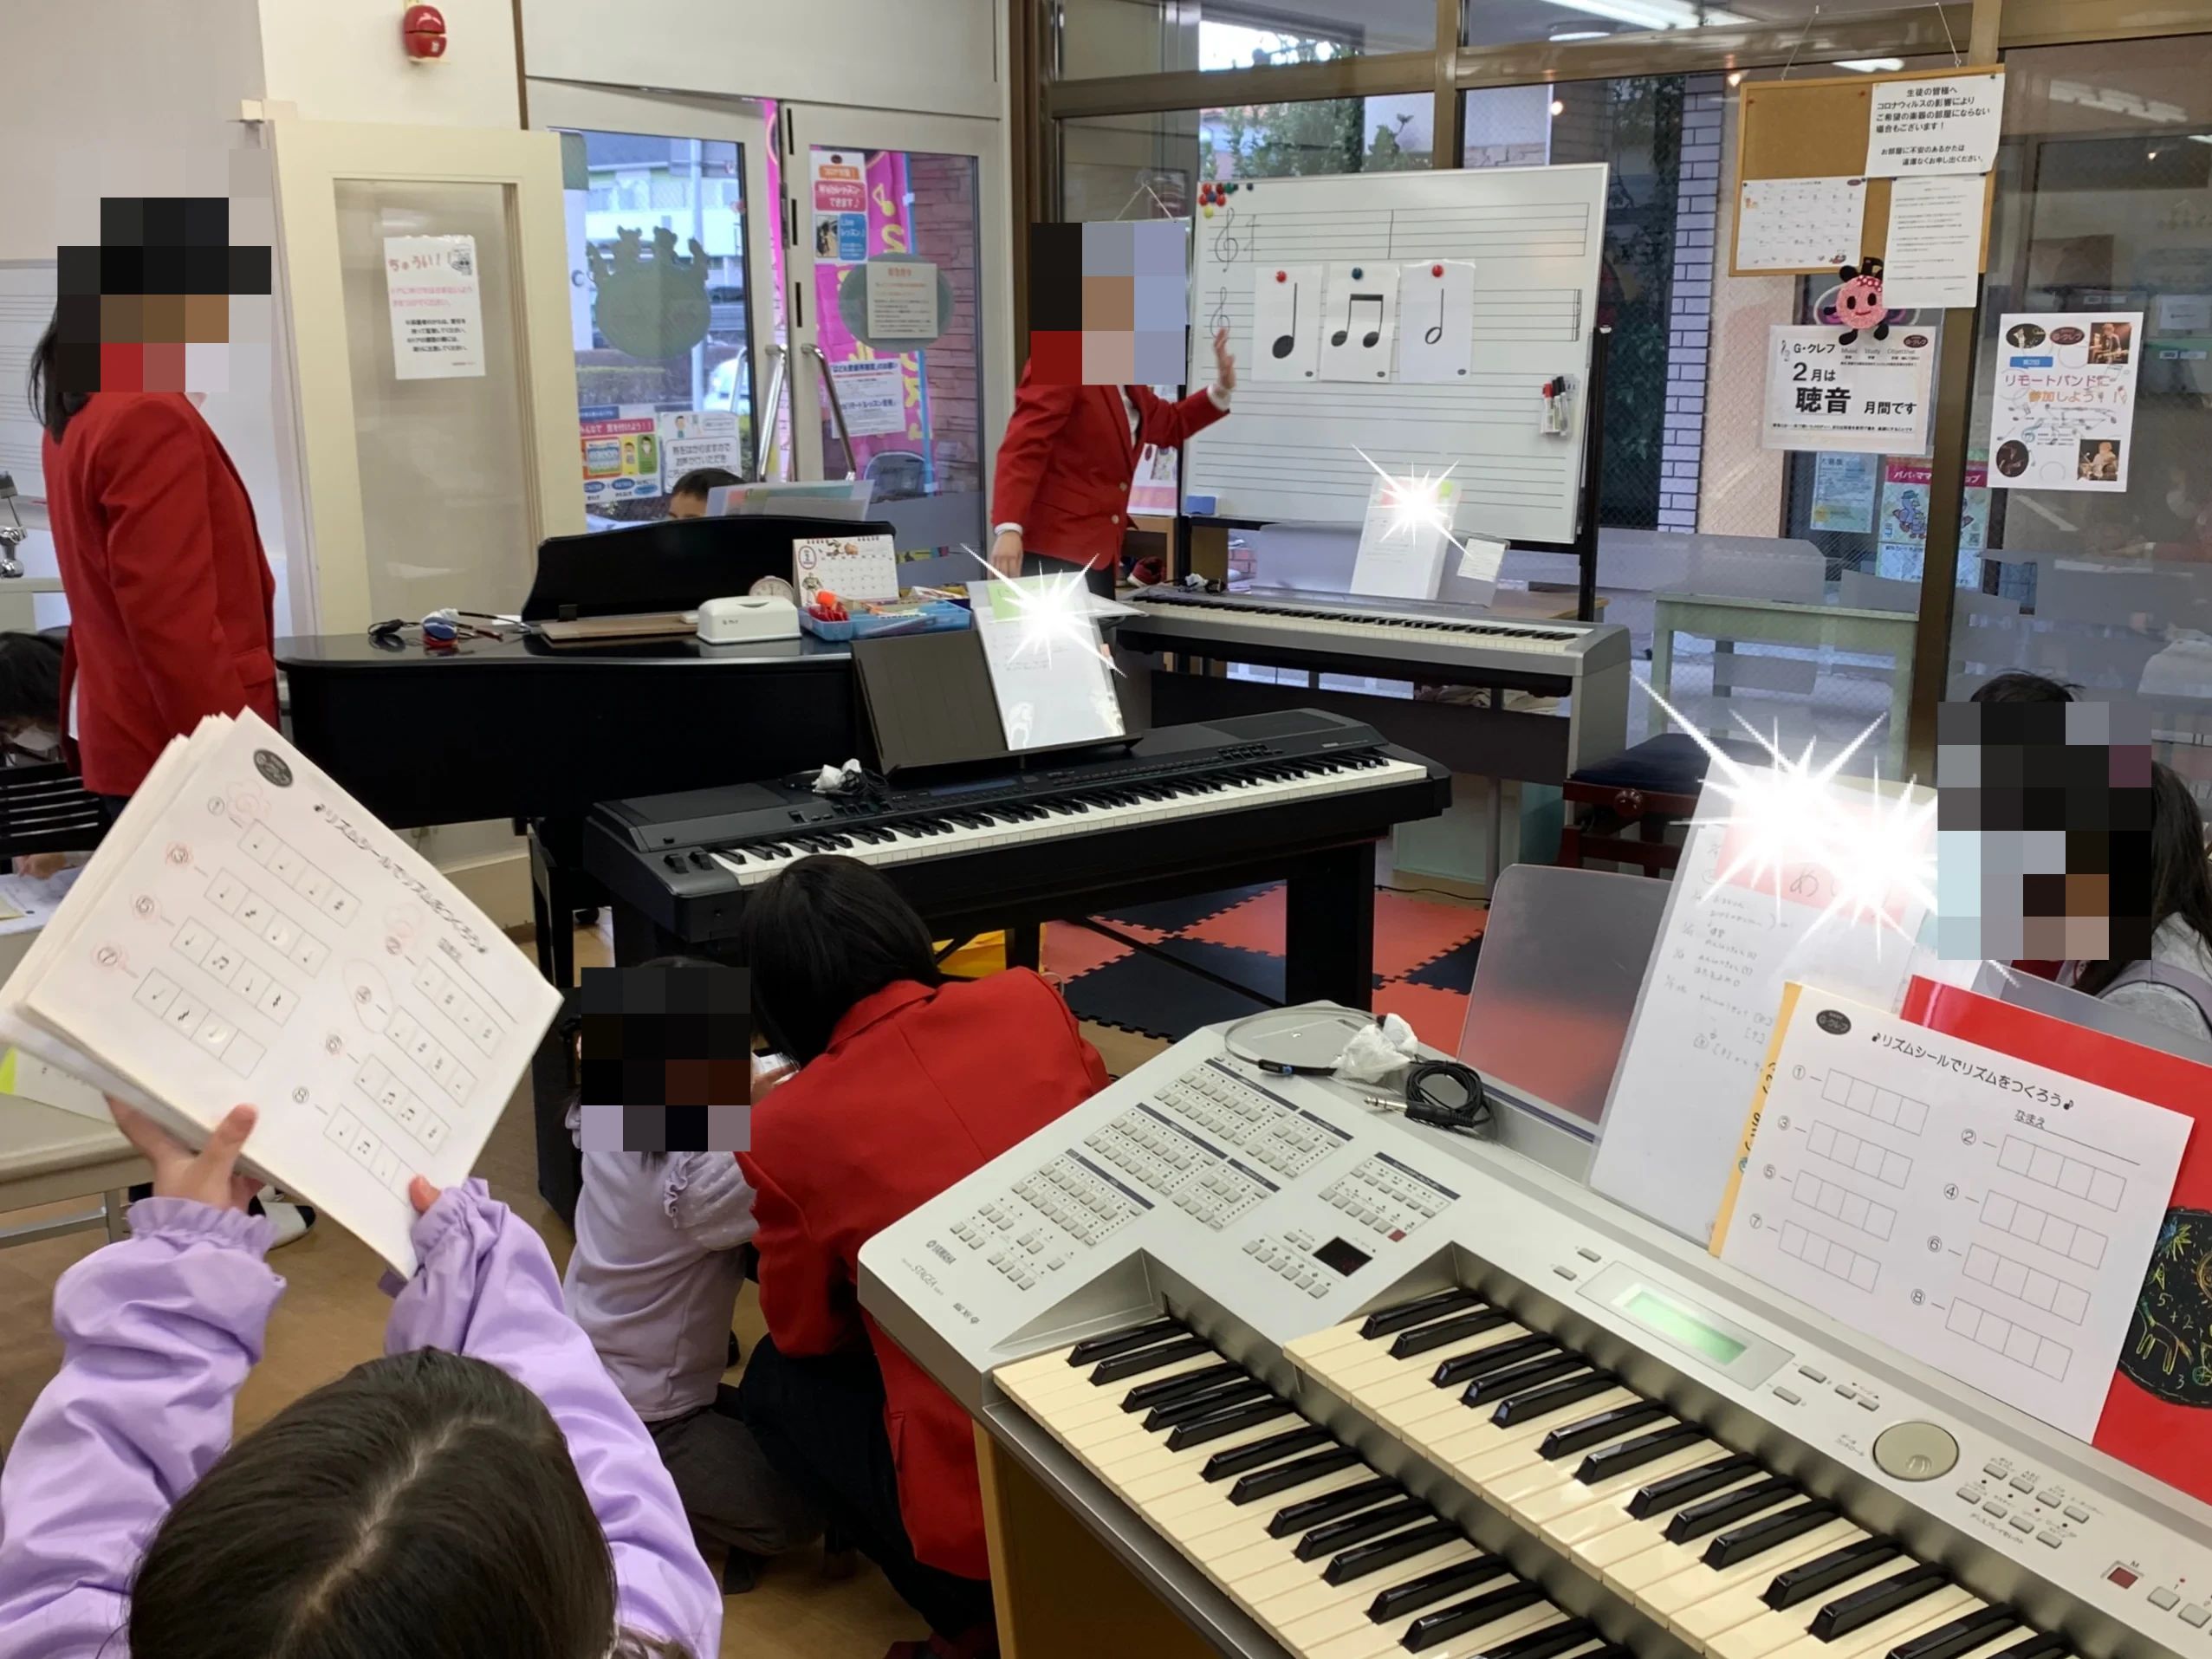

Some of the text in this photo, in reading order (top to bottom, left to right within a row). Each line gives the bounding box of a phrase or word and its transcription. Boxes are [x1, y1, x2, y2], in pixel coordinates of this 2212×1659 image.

[1906, 87, 1957, 97] 生徒の皆様へ
[1877, 97, 1975, 110] コロナウィルスの影響により
[1876, 108, 1990, 121] ご希望の楽器の部屋にならない
[1881, 145, 1965, 155] お部屋に不安のあるかたは
[2005, 375, 2111, 387] リモートバンドに
[1795, 386, 1917, 416] 聴音 月間です
[1881, 1034, 2063, 1108] リズムシールでリズムをつくろう
[2014, 1110, 2046, 1129] なまえ
